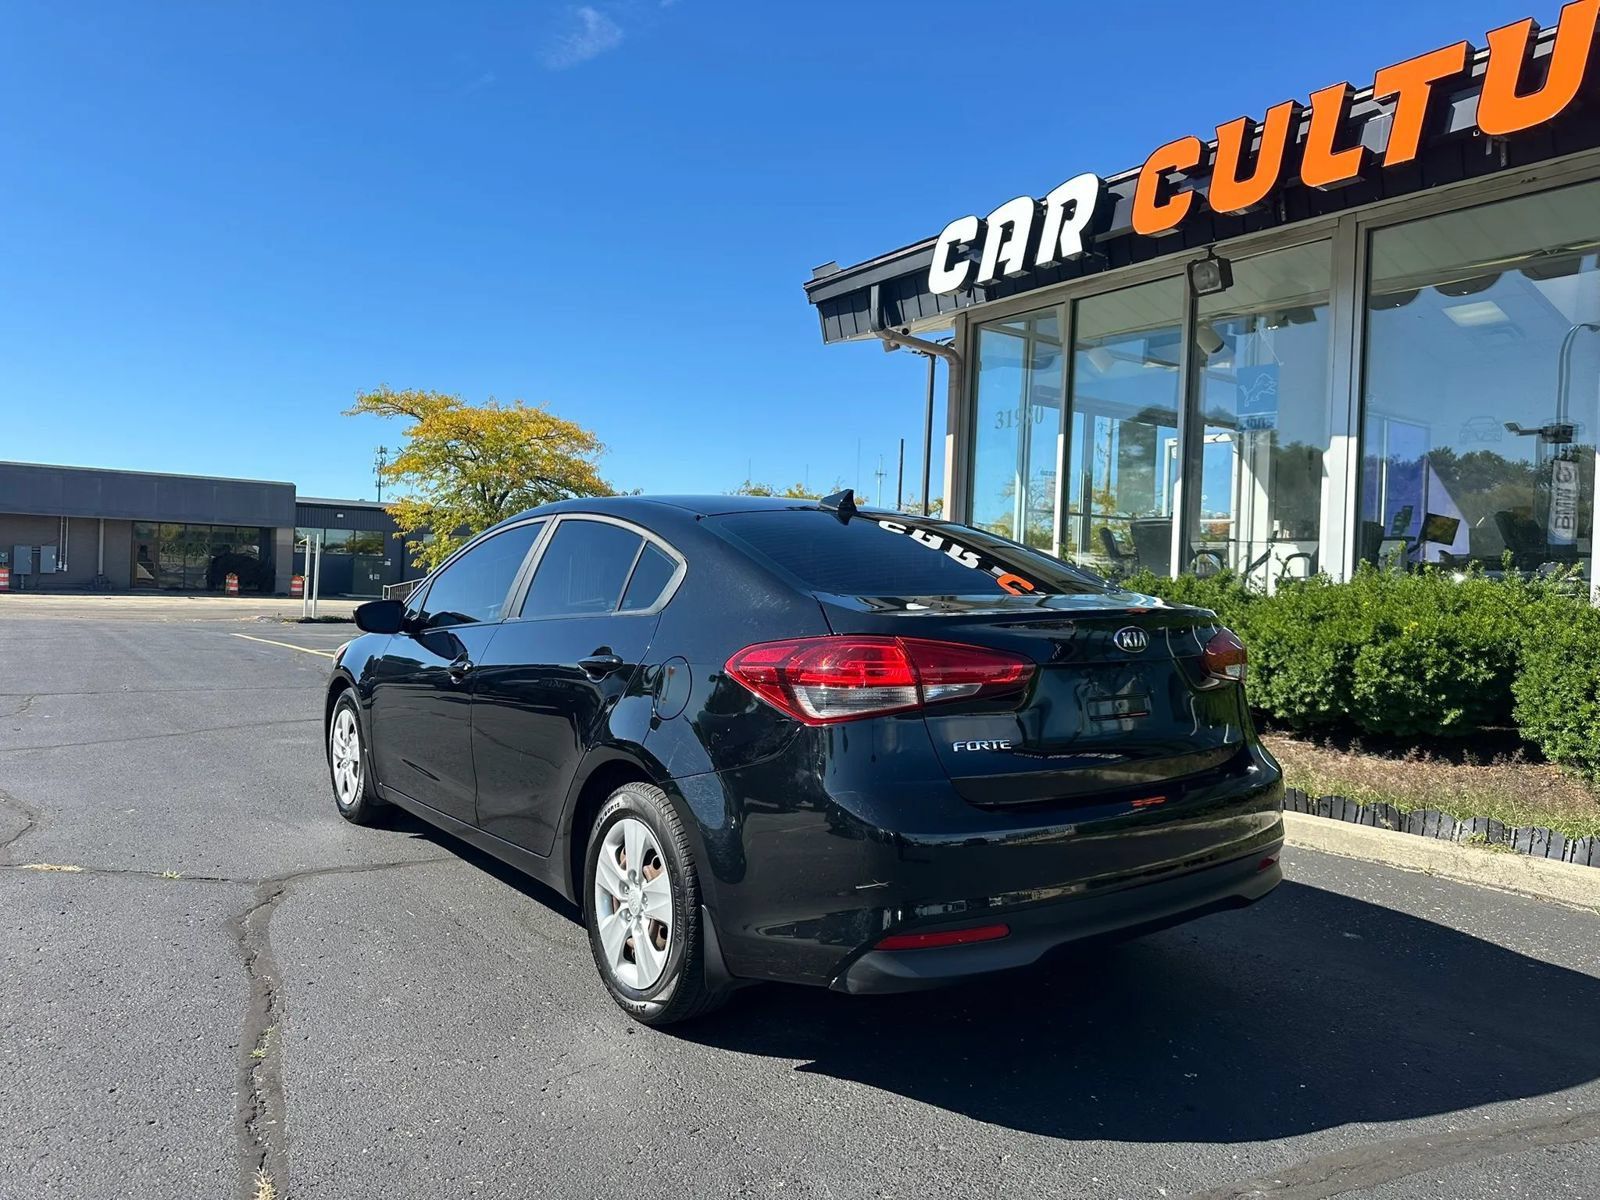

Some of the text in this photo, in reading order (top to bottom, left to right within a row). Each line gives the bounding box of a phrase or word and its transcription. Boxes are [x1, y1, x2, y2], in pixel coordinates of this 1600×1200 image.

[928, 0, 1600, 294] CAR CULTU
[1555, 487, 1576, 530] BMW
[1121, 631, 1147, 648] KIA
[952, 739, 1012, 752] FORTE
